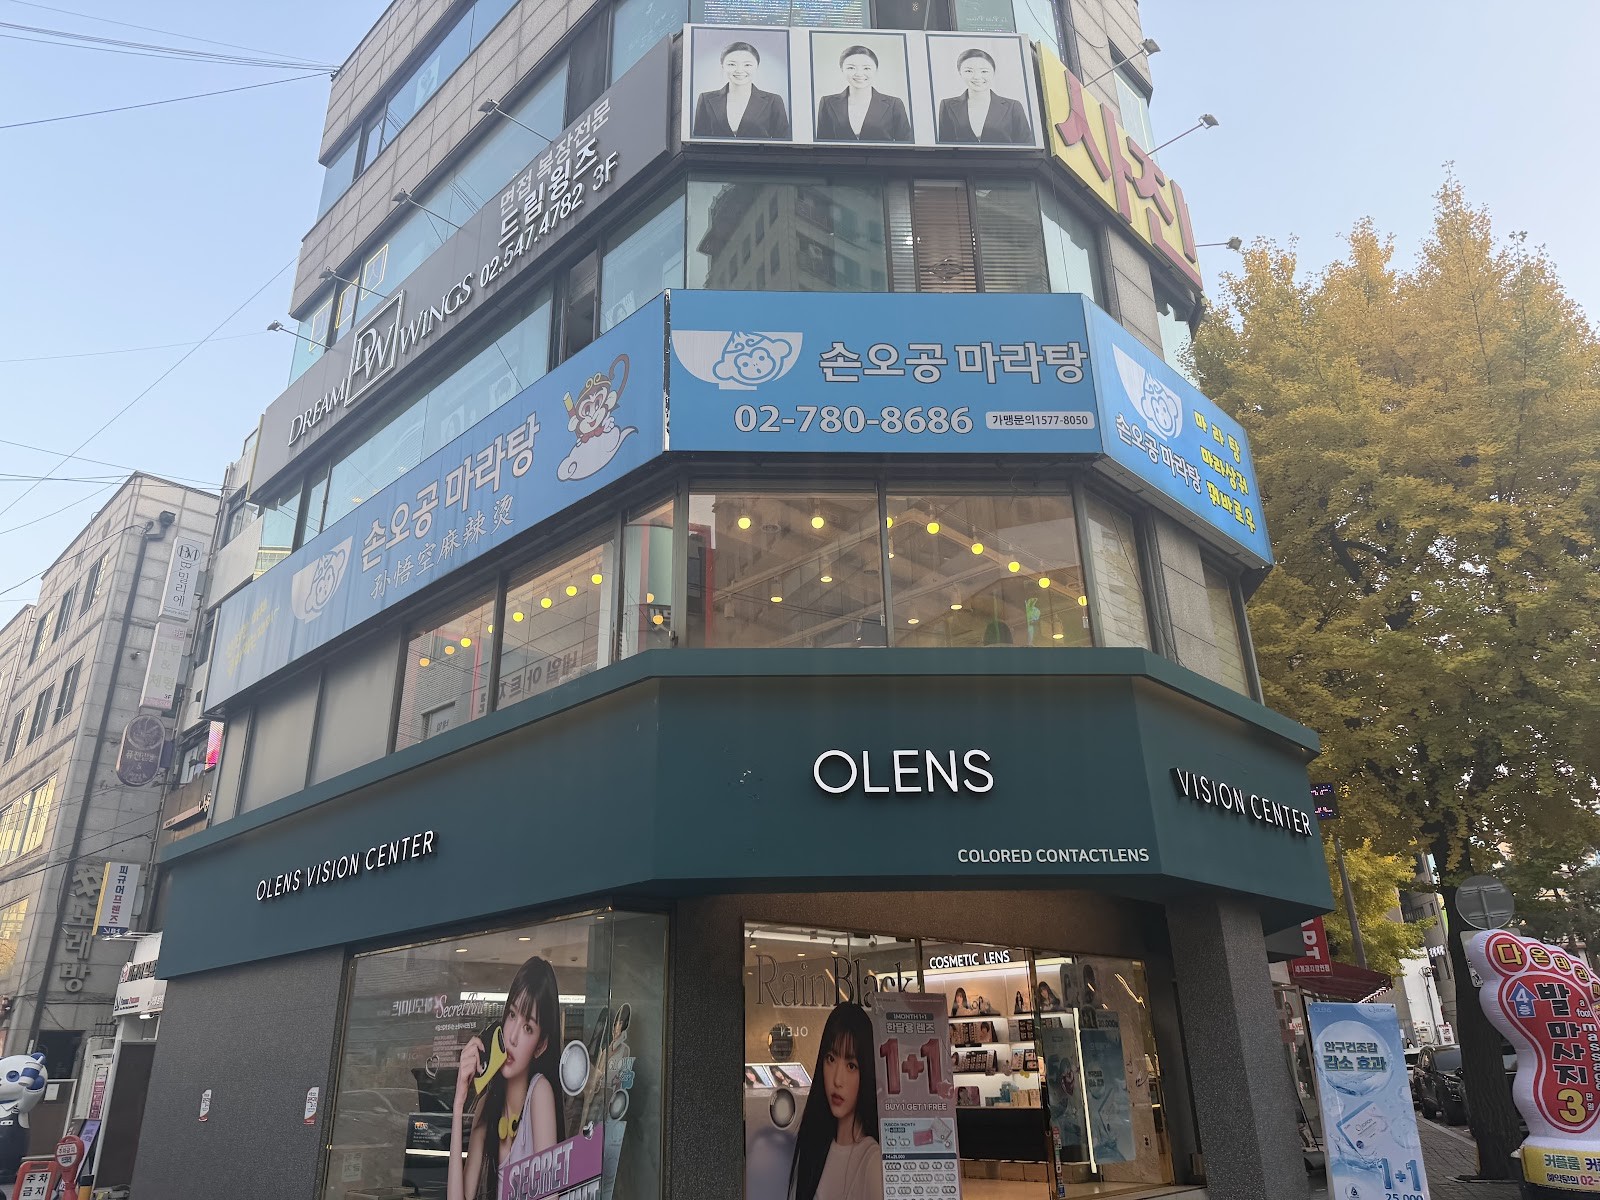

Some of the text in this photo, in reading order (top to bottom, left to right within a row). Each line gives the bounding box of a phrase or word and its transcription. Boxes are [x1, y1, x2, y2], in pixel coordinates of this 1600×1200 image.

[500, 97, 611, 214] 면접 복장전문
[498, 138, 599, 246] 드림윙즈
[1055, 69, 1203, 290] 사진
[287, 377, 348, 447] DREAM
[400, 272, 474, 354] WINGS
[479, 185, 584, 288] 02.547.4782
[592, 150, 619, 192] 3F
[819, 341, 1089, 385] 손오공 마라탕
[734, 403, 974, 435] 02-780-8686
[1115, 411, 1201, 494] 손오공 마라탕
[361, 411, 541, 573] 손오공 마라탕
[370, 494, 515, 601] 孙悟空麻辣烫
[812, 748, 995, 794] OLENS
[1172, 766, 1313, 838] VISION CENTER
[256, 830, 434, 901] OLENS VISION CENTER
[957, 847, 1150, 863] COLORED CONTACTLENS
[929, 950, 1011, 969] COSMETIC LENS
[886, 1022, 935, 1034] 한달용 렌즈
[1324, 1041, 1379, 1054] 안구건조감
[1534, 982, 1589, 1085] 발마사지
[880, 1038, 943, 1095] 1+1
[1323, 1055, 1387, 1073] 감소 효과
[885, 1103, 900, 1111] BUY
[906, 1103, 922, 1111] GET
[928, 1103, 947, 1111] FREE
[1557, 1088, 1588, 1124] 3
[26, 1173, 48, 1184] 주차
[508, 1140, 574, 1200] SECRET
[1377, 1157, 1421, 1192] 1+1
[1544, 1154, 1600, 1172] 커플룸 커
[22, 1186, 45, 1197] 금지
